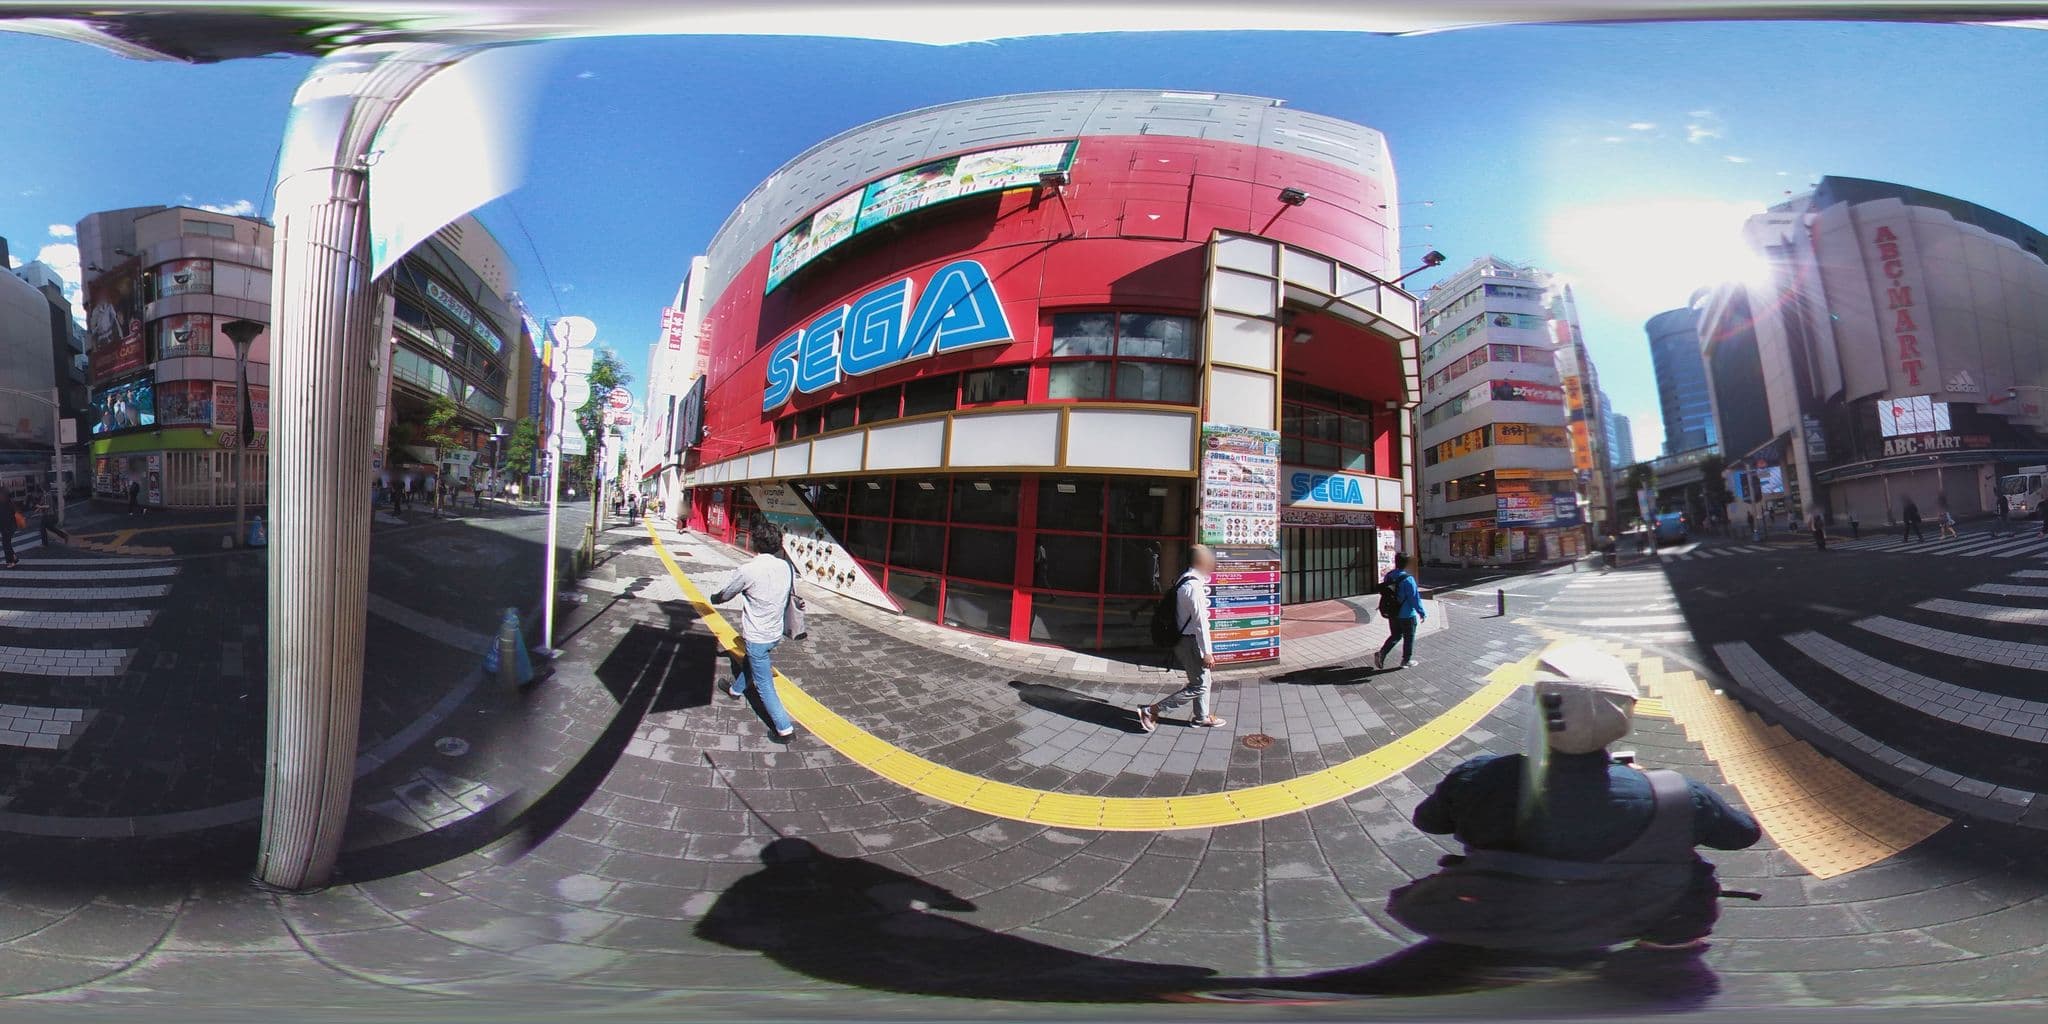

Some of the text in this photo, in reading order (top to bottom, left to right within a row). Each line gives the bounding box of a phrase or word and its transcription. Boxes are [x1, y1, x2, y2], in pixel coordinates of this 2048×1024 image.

[763, 259, 1015, 412] SEGA
[1884, 436, 1961, 457] ABC-MART
[1291, 472, 1364, 505] SEGA
